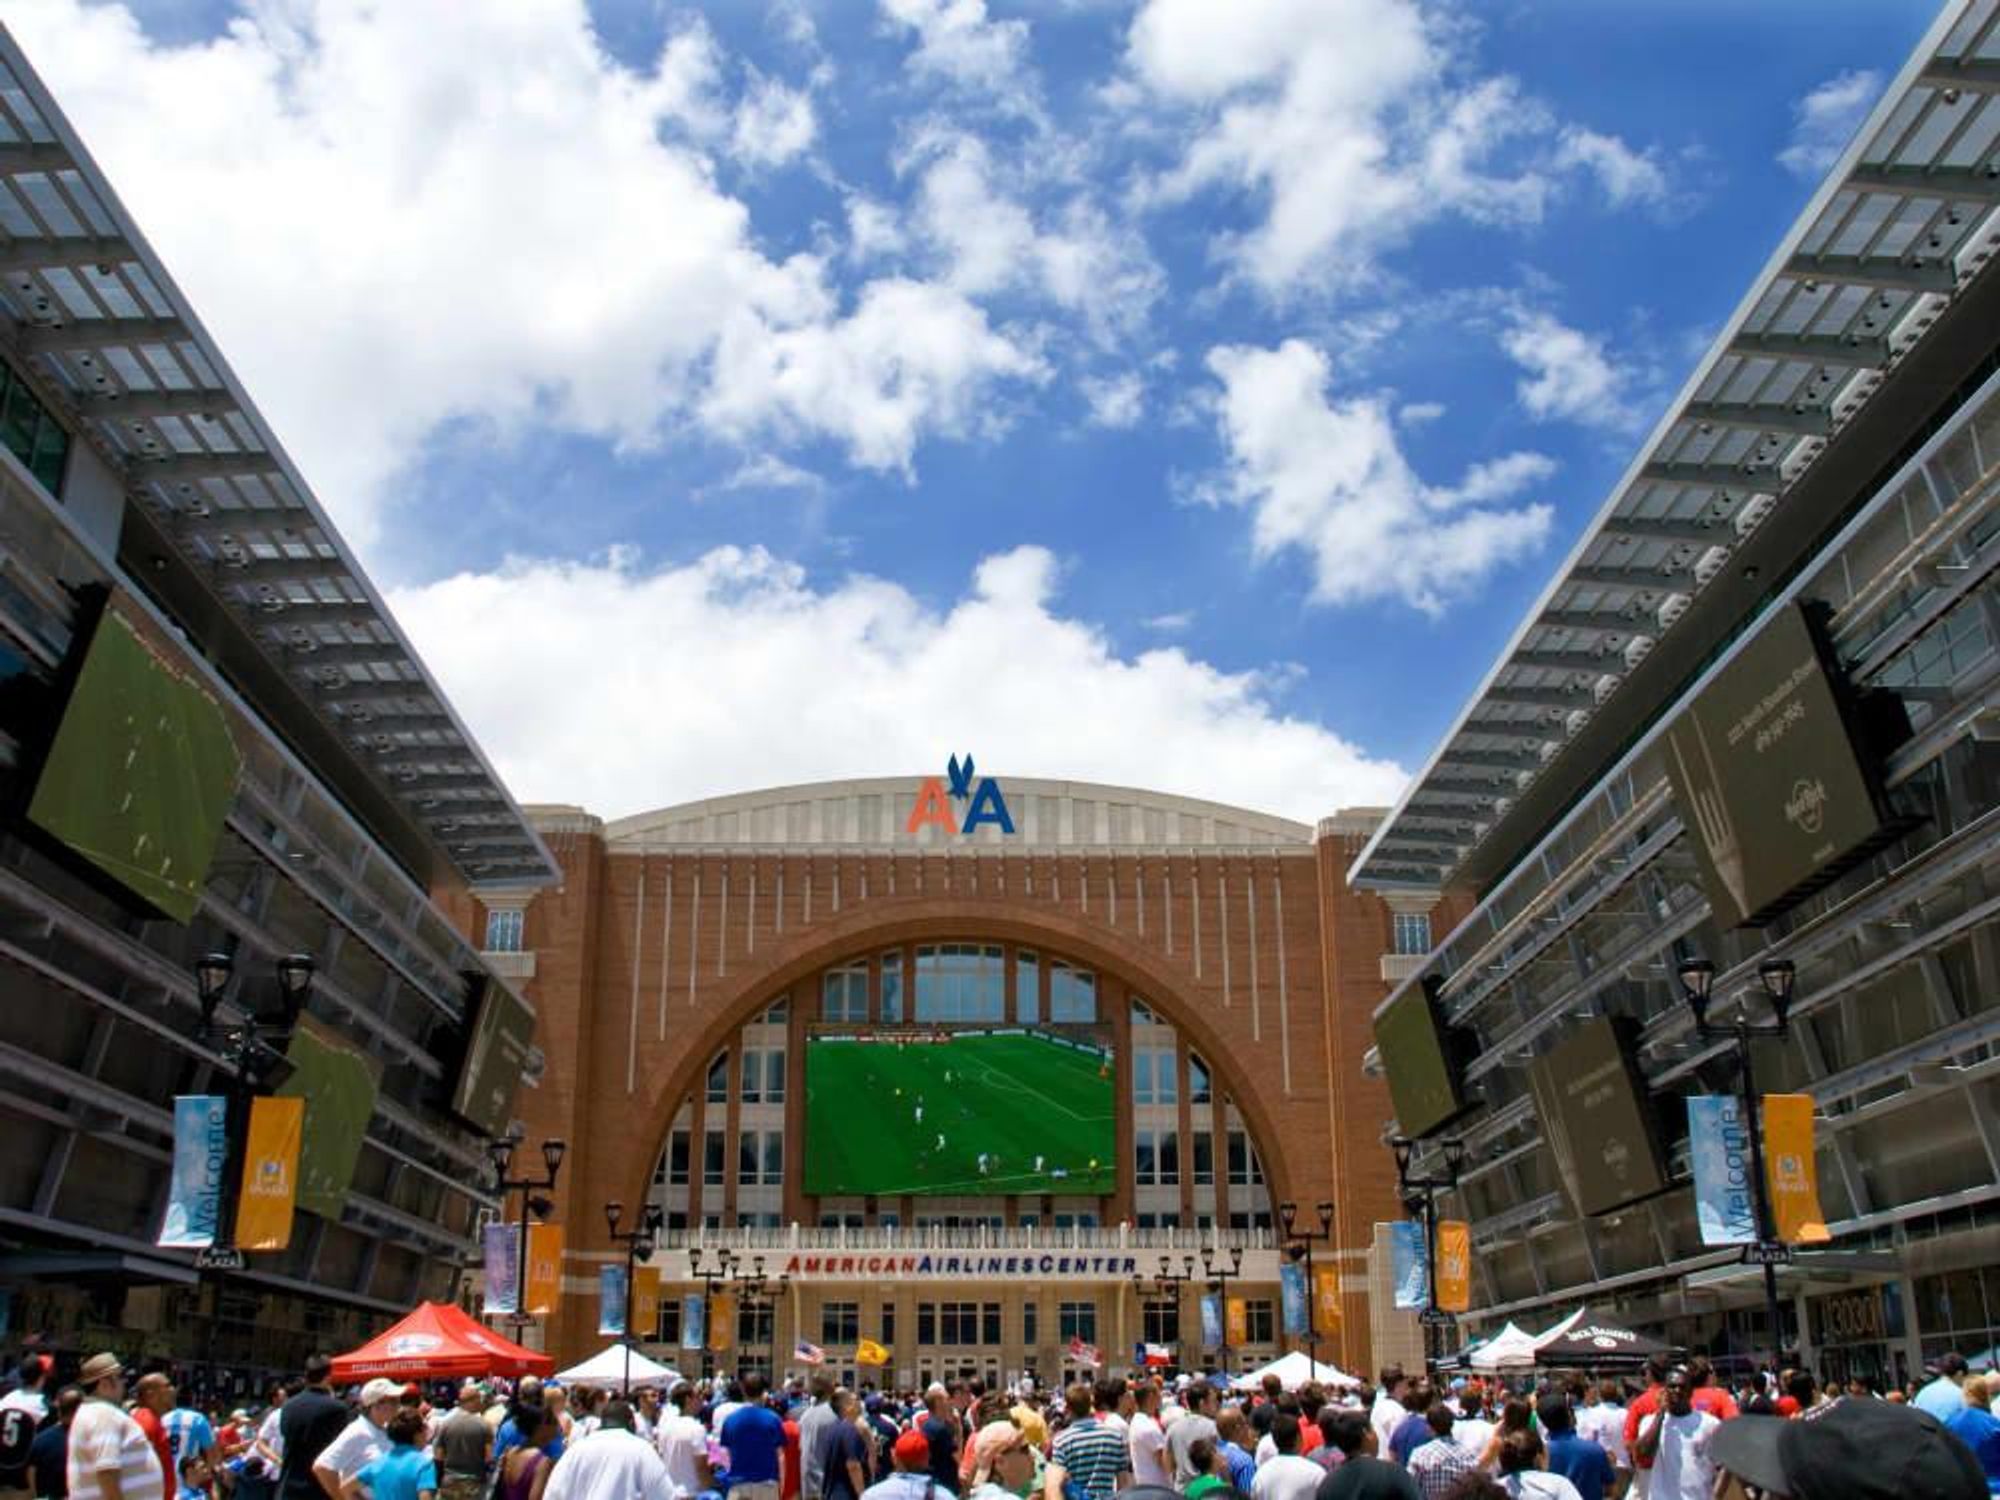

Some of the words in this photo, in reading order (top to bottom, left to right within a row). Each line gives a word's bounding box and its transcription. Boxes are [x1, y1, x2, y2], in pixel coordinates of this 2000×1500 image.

[192, 1110, 224, 1240] Welcome
[1722, 1109, 1756, 1238] Welcome
[1039, 1255, 1136, 1274] CENTER
[1754, 1251, 1786, 1262] PLAZA
[3, 1410, 22, 1446] 5
